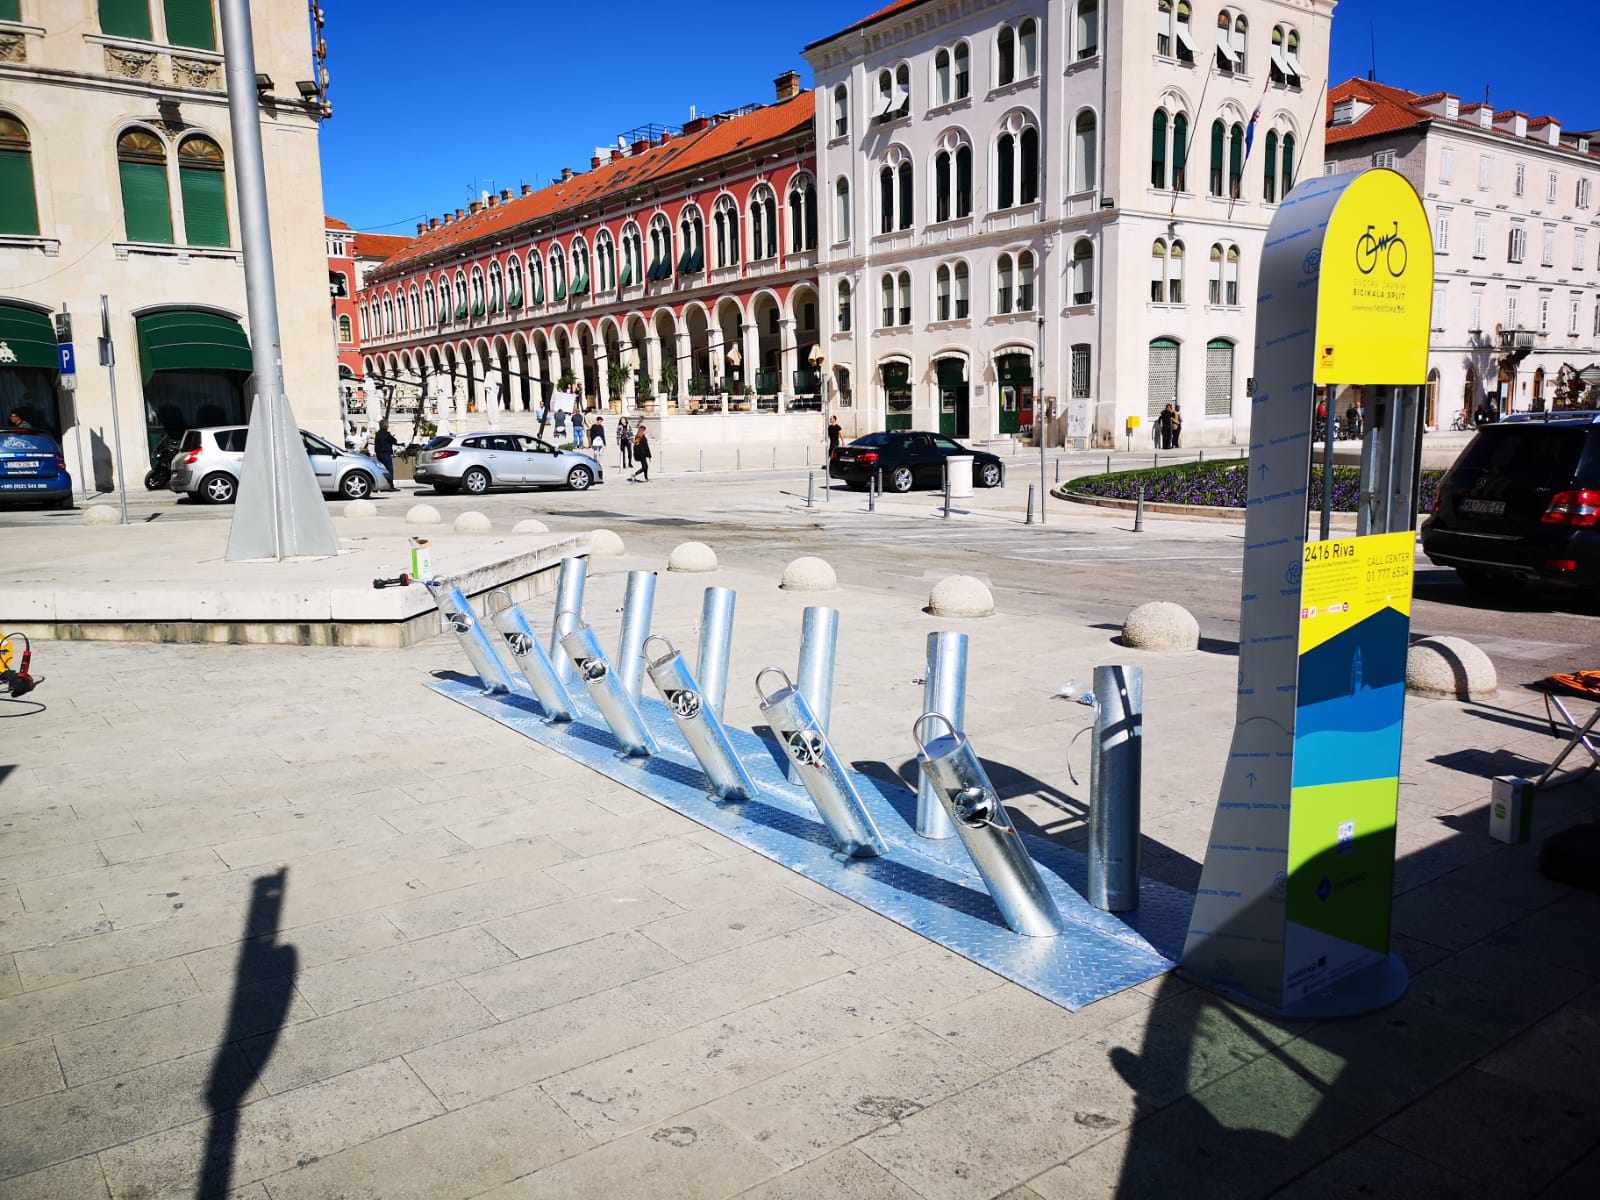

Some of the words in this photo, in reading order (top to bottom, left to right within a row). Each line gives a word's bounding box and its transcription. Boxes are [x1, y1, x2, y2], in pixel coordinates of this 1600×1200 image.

[61, 349, 70, 369] P
[1304, 545, 1330, 562] 2416
[1332, 543, 1355, 559] Riva
[1367, 555, 1384, 567] CALL
[1385, 552, 1409, 564] CENTER
